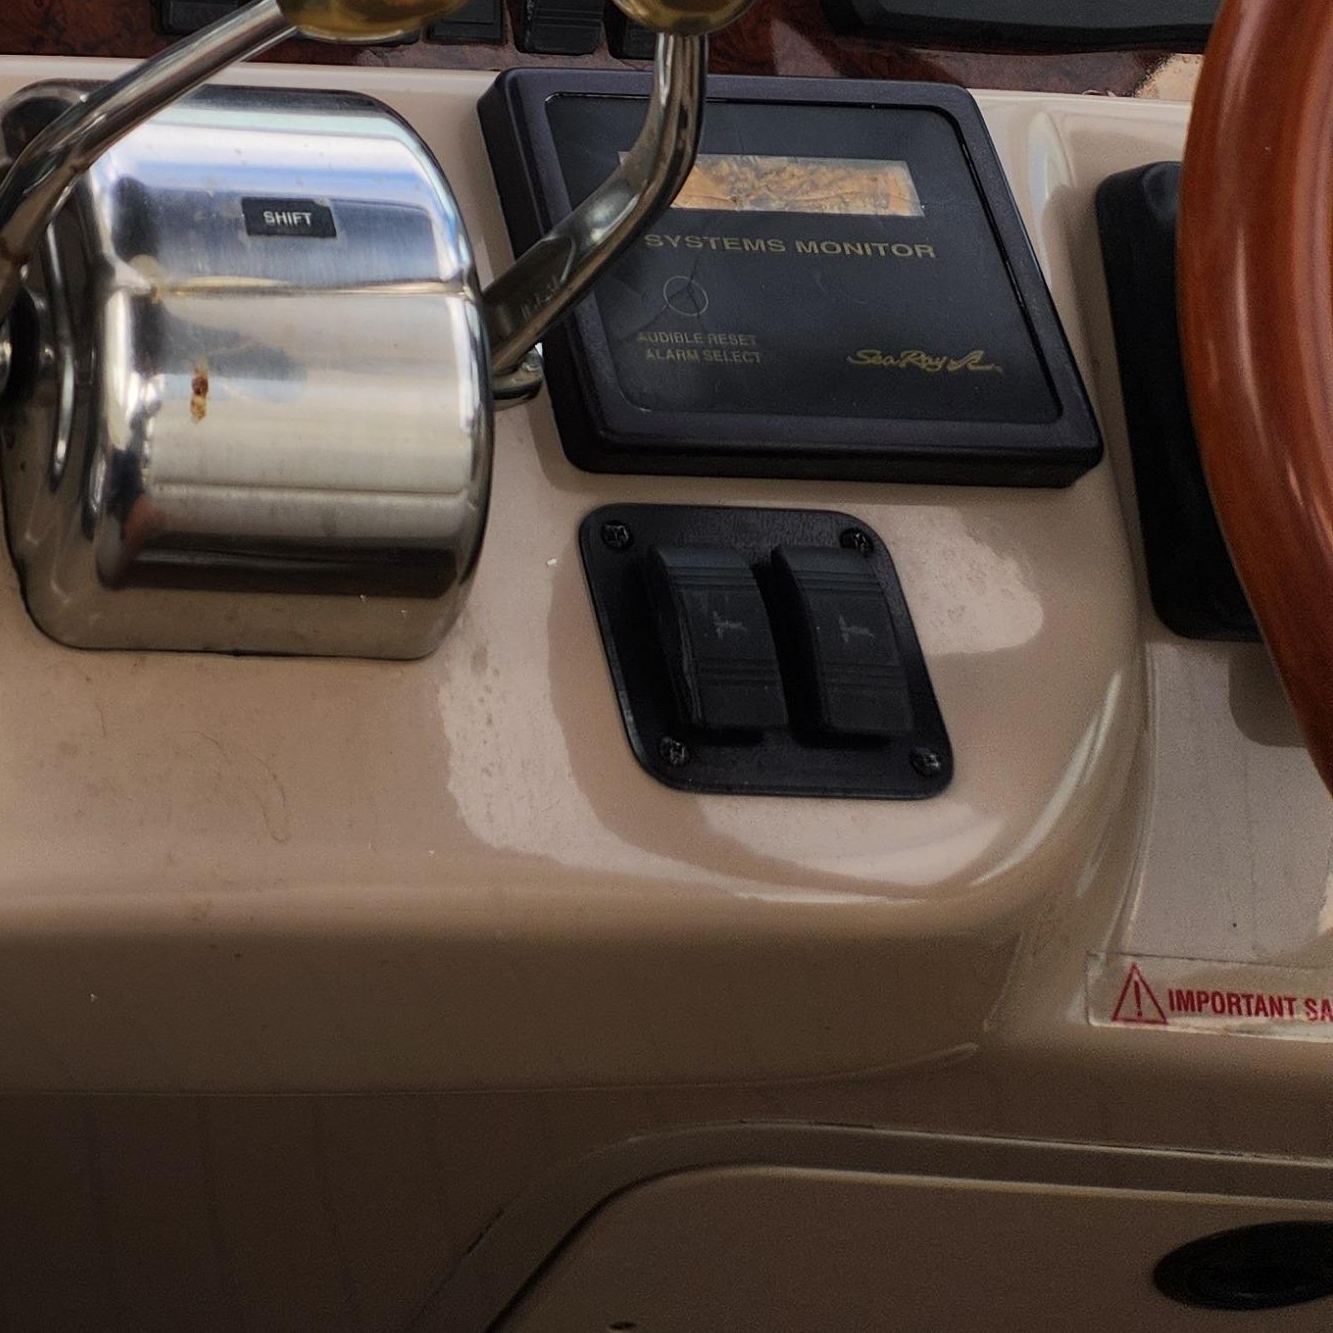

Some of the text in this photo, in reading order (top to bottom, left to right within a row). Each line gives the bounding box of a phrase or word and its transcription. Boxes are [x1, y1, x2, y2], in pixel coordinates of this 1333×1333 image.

[262, 210, 312, 226] SHIFT
[644, 233, 937, 259] SYSTEMS MONITOR
[637, 331, 757, 346] AUDIBLE RESET
[645, 350, 762, 364] ALARM SELECT
[1168, 988, 1297, 1019] IMPORTANT
